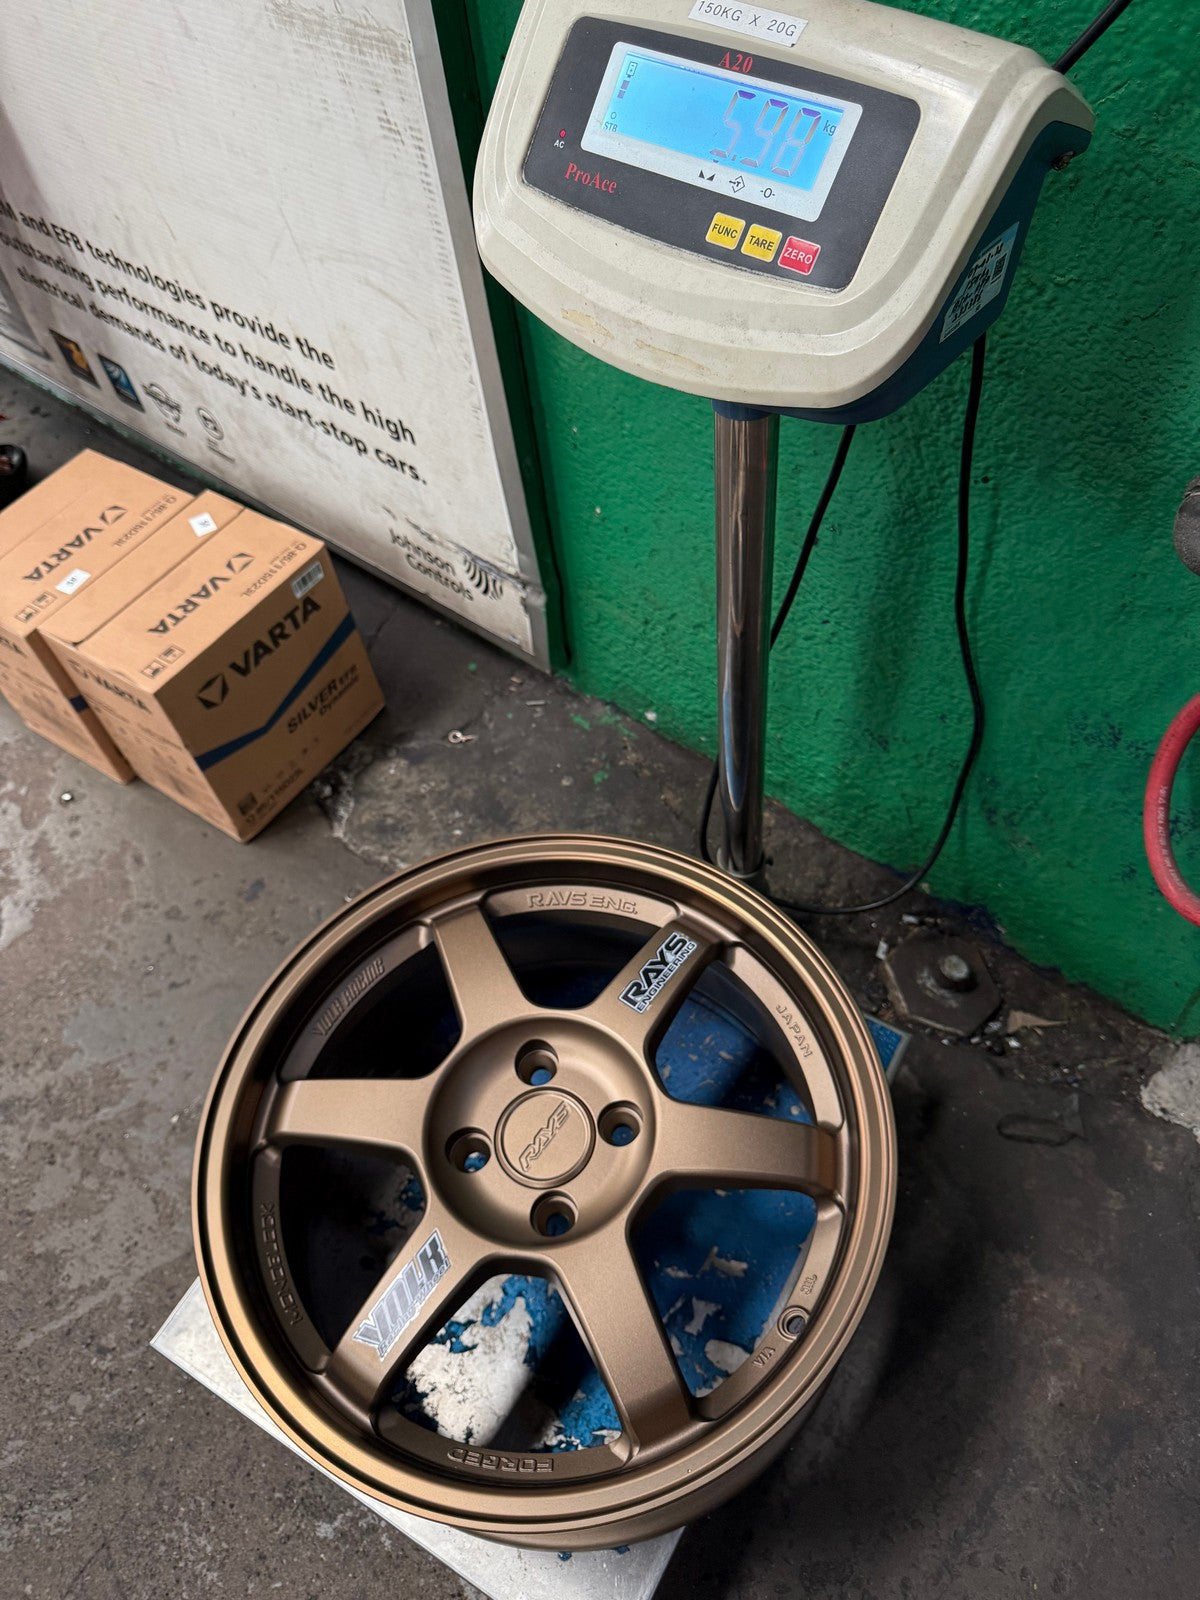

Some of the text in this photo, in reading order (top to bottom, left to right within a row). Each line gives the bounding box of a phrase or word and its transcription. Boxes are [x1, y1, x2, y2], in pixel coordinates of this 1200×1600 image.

[697, 0, 797, 37] 150KG X 20G
[718, 51, 754, 74] A20
[553, 139, 566, 149] AC
[602, 120, 618, 134] STB
[709, 89, 838, 178] 5.98 kg
[564, 161, 618, 194] ProAce
[711, 223, 739, 240] FUNC
[748, 235, 775, 253] TARE
[783, 247, 814, 267] ZERO
[19, 211, 53, 238] and
[50, 222, 85, 253] EFB
[85, 239, 207, 311] technologies
[210, 298, 293, 350] provide
[295, 336, 336, 370] the
[95, 278, 212, 347] performance
[213, 333, 238, 358] to
[239, 343, 314, 395] handle
[317, 383, 357, 416] the
[360, 400, 417, 446] high
[88, 300, 167, 353] demands
[168, 346, 189, 365] of
[191, 352, 263, 401] today's
[265, 392, 368, 457] start-stop
[373, 447, 428, 486] cars.
[22, 527, 103, 581] VARTA
[388, 527, 457, 577] Johnson
[405, 552, 475, 602] Controls
[148, 576, 231, 635] VARTA
[228, 595, 321, 678] VARTA
[287, 678, 339, 734] SILVER
[589, 896, 638, 915] ENG.
[622, 933, 688, 1007] RAYS
[636, 942, 695, 1012] ENGINEERING
[776, 1004, 814, 1058] JAPAN
[518, 1100, 569, 1172] RAYS
[354, 1230, 447, 1345] VOLK
[752, 1346, 776, 1369] VIA
[447, 1448, 555, 1473] FORGED
